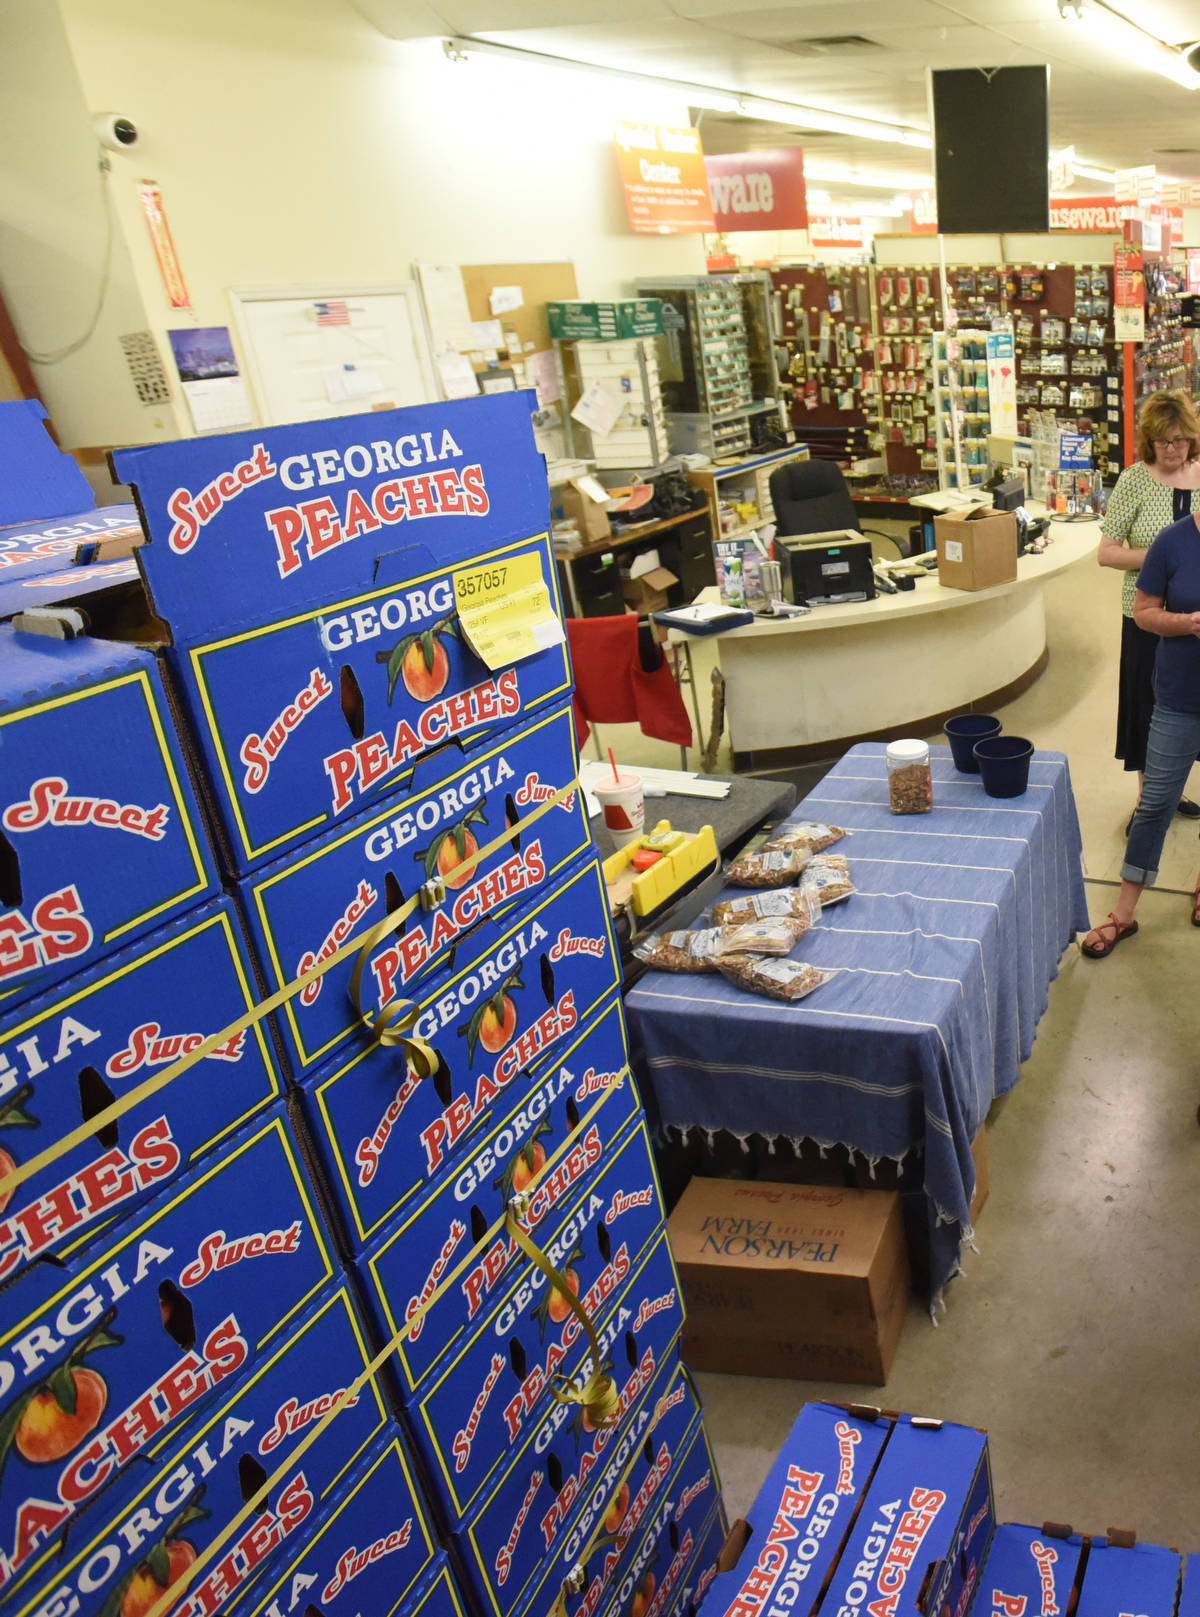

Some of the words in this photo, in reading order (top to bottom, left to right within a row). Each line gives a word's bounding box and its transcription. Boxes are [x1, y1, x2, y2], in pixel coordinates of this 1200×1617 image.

[1050, 205, 1124, 230] useware
[168, 443, 276, 556] Sweet
[278, 428, 463, 492] GEORGIA
[264, 463, 489, 578] PEACHES
[320, 579, 455, 653] GEORG
[457, 567, 508, 598] 357057
[240, 667, 333, 794] Sweet
[323, 669, 521, 817] PEACHES
[2, 777, 170, 841] Sweet
[364, 757, 515, 862] GEORGIA
[515, 772, 575, 813] Sweet
[296, 879, 378, 1006] Sweet
[370, 838, 546, 1010] PEACHES
[411, 920, 549, 1041] GEORGIA
[549, 928, 606, 963] Sweet
[420, 988, 578, 1178] PEACHES
[453, 1066, 575, 1202] GEORGIA
[179, 1220, 303, 1289] Sweet
[605, 1184, 653, 1226] Sweet
[698, 1234, 840, 1264] PEARSON
[699, 1216, 775, 1237] FARM
[789, 1189, 844, 1208] Georgia
[811, 1227, 846, 1238] SINCE
[404, 1218, 467, 1343] Sweet
[494, 1193, 604, 1337] GEORGIA
[632, 1287, 676, 1335] Sweet
[502, 1241, 631, 1446] PEACHES
[452, 1352, 506, 1474] Sweet
[835, 1421, 863, 1496] Sweet
[37, 1415, 255, 1617] EORGIA
[495, 1469, 544, 1587] Sweet
[563, 1408, 650, 1563] GEORGIA
[675, 1468, 712, 1522] Sweet
[723, 1463, 825, 1617] PEACHE
[322, 1518, 413, 1605] Sweet
[608, 1500, 675, 1617] EORGIA
[767, 1493, 840, 1617] GEORGI
[866, 1486, 948, 1617] ACHES
[1030, 1540, 1060, 1617] Sweet
